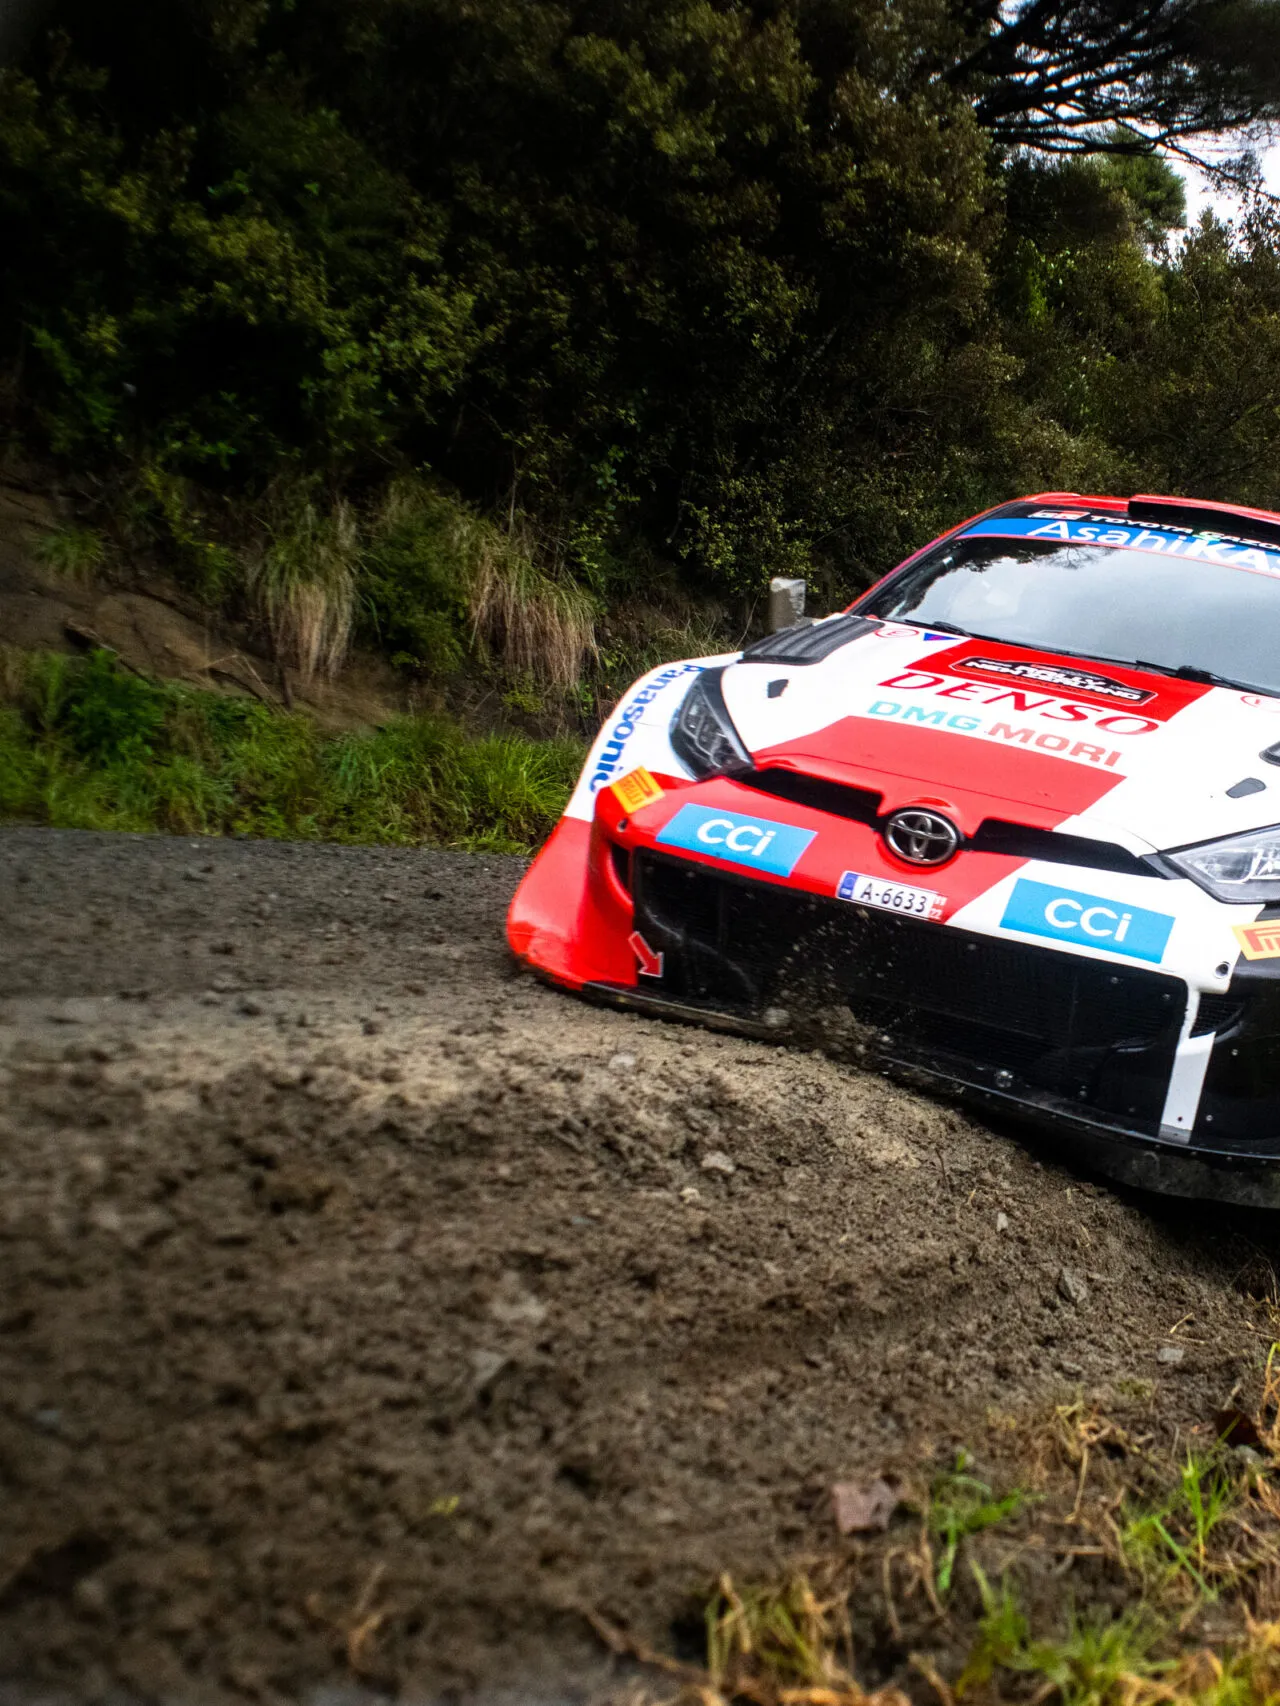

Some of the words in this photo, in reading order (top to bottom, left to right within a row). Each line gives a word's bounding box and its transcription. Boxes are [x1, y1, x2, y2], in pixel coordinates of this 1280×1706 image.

[1091, 514, 1194, 534] TOYOTA
[590, 664, 707, 793] Panasonic
[867, 700, 982, 731] DMG
[987, 721, 1123, 767] MORI
[876, 671, 1160, 736] DENSO
[860, 882, 927, 913] A-6633
